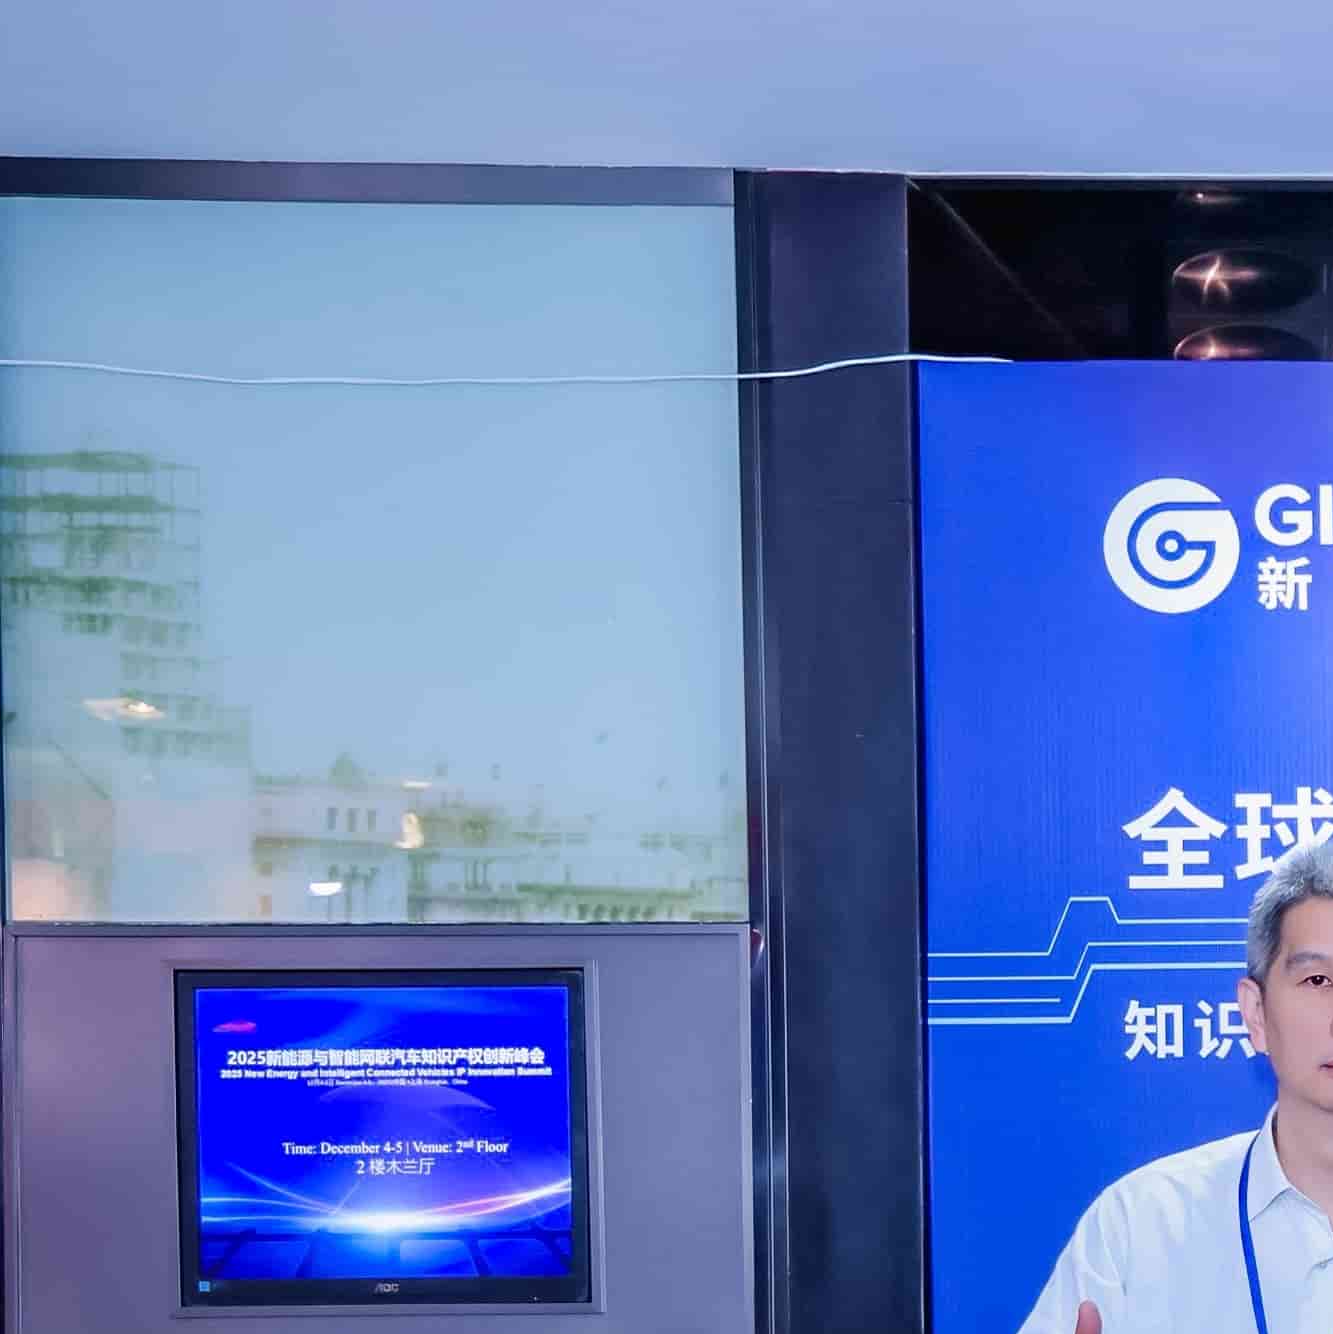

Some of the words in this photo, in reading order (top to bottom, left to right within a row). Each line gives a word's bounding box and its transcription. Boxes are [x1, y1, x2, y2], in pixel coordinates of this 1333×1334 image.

[282, 1142, 318, 1155] Time:
[320, 1142, 381, 1155] December
[383, 1141, 403, 1154] 4-5
[413, 1141, 453, 1154] Venue:
[477, 1140, 510, 1154] Floor
[369, 1160, 436, 1176] 楼木兰厅
